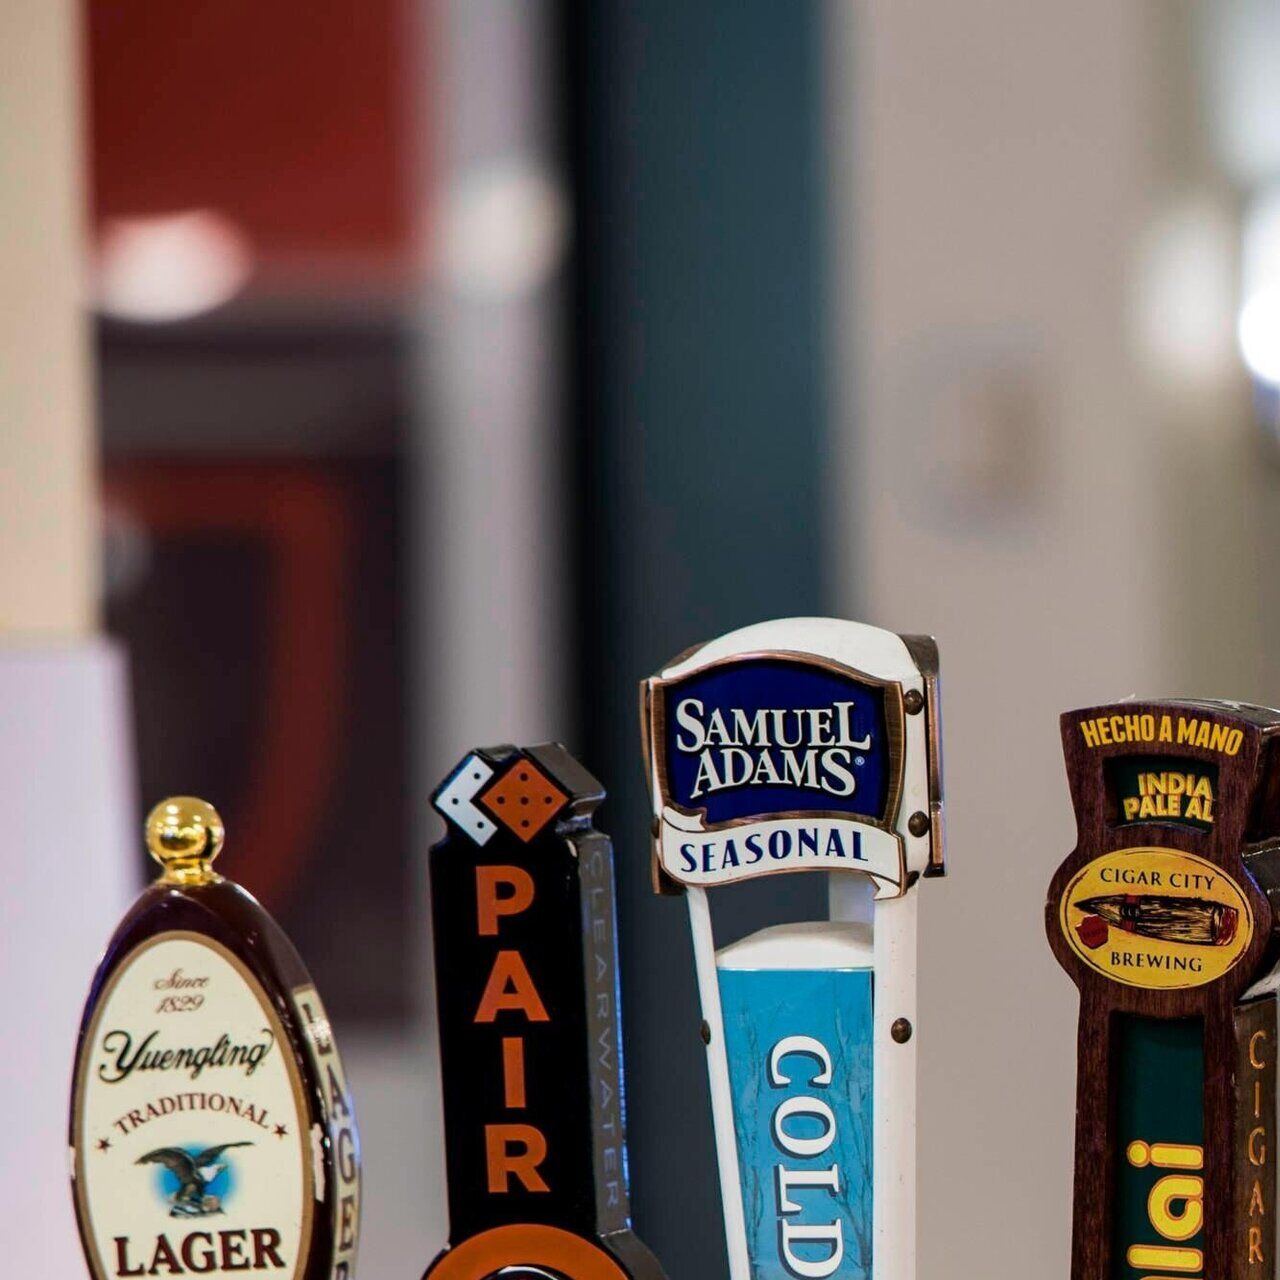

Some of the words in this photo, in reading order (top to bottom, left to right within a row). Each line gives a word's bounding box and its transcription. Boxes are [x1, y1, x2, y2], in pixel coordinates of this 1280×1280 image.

[675, 698, 871, 752] SAMUEL
[1080, 714, 1154, 748] HECHO
[1160, 715, 1173, 742] A
[1177, 717, 1244, 756] MANO
[689, 747, 856, 799] ADAMS
[1138, 772, 1213, 800] INDIA
[1123, 795, 1181, 820] PALE
[1185, 797, 1214, 822] AL
[680, 827, 869, 873] SEASONAL
[1100, 867, 1161, 886] CIGAR
[1169, 873, 1216, 890] CITY
[154, 968, 210, 991] Since
[1111, 951, 1202, 972] BREWING
[156, 994, 205, 1014] 1829
[473, 865, 551, 1194] PAIR
[582, 848, 620, 1208] CLEARWATER
[99, 1028, 274, 1084] Yuengling
[113, 1092, 272, 1136] TRADITIONAL
[1247, 1030, 1266, 1265] CIGAR
[114, 1226, 286, 1277] LAGER
